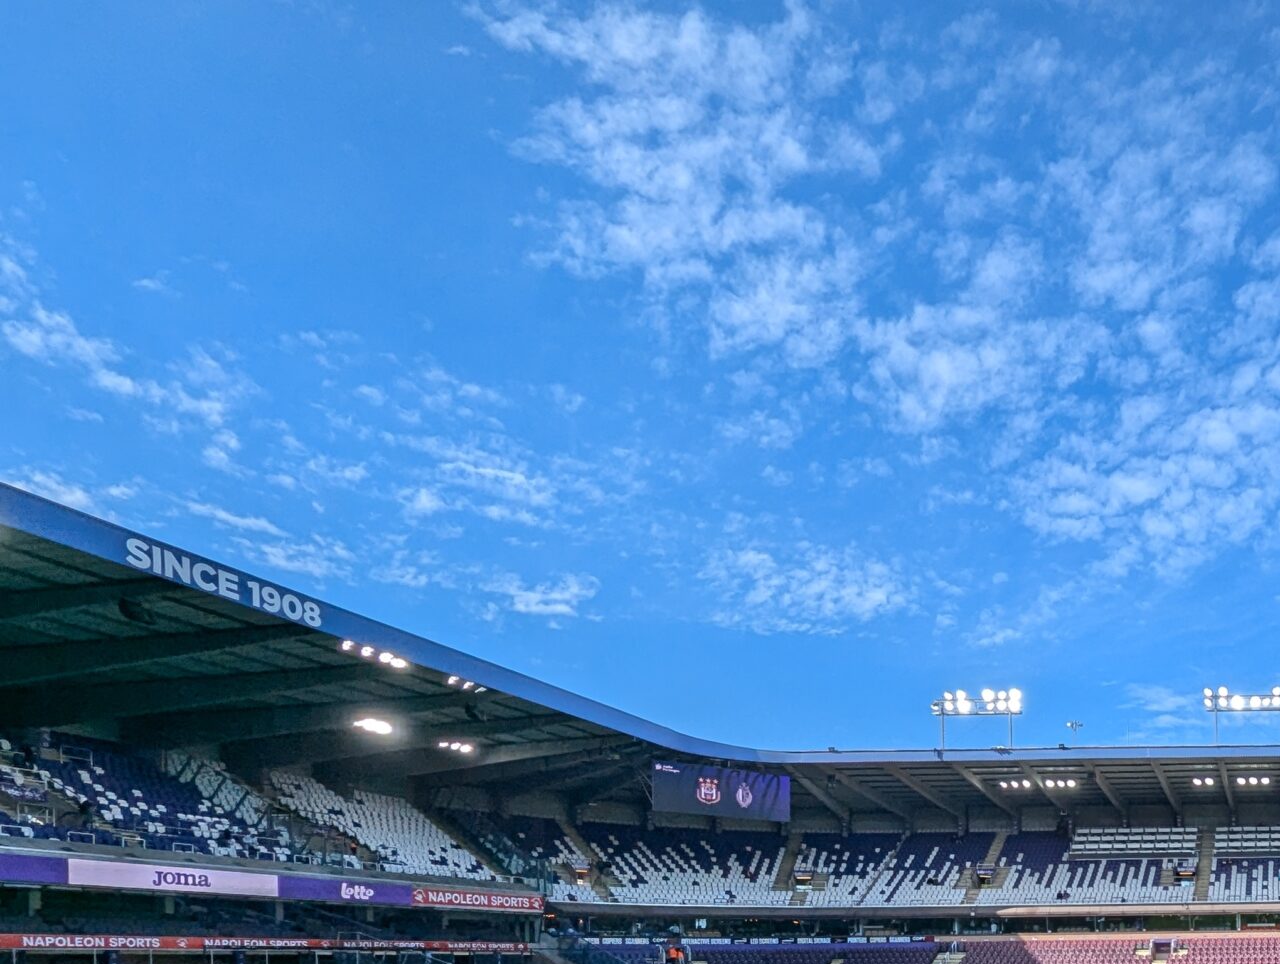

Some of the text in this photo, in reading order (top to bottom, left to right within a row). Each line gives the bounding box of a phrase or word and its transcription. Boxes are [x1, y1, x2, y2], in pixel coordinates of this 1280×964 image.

[126, 538, 322, 627] SINCE 1908
[428, 891, 529, 908] NAPOLEON SPORTS
[22, 936, 160, 948] NAPOLEON SPORTS
